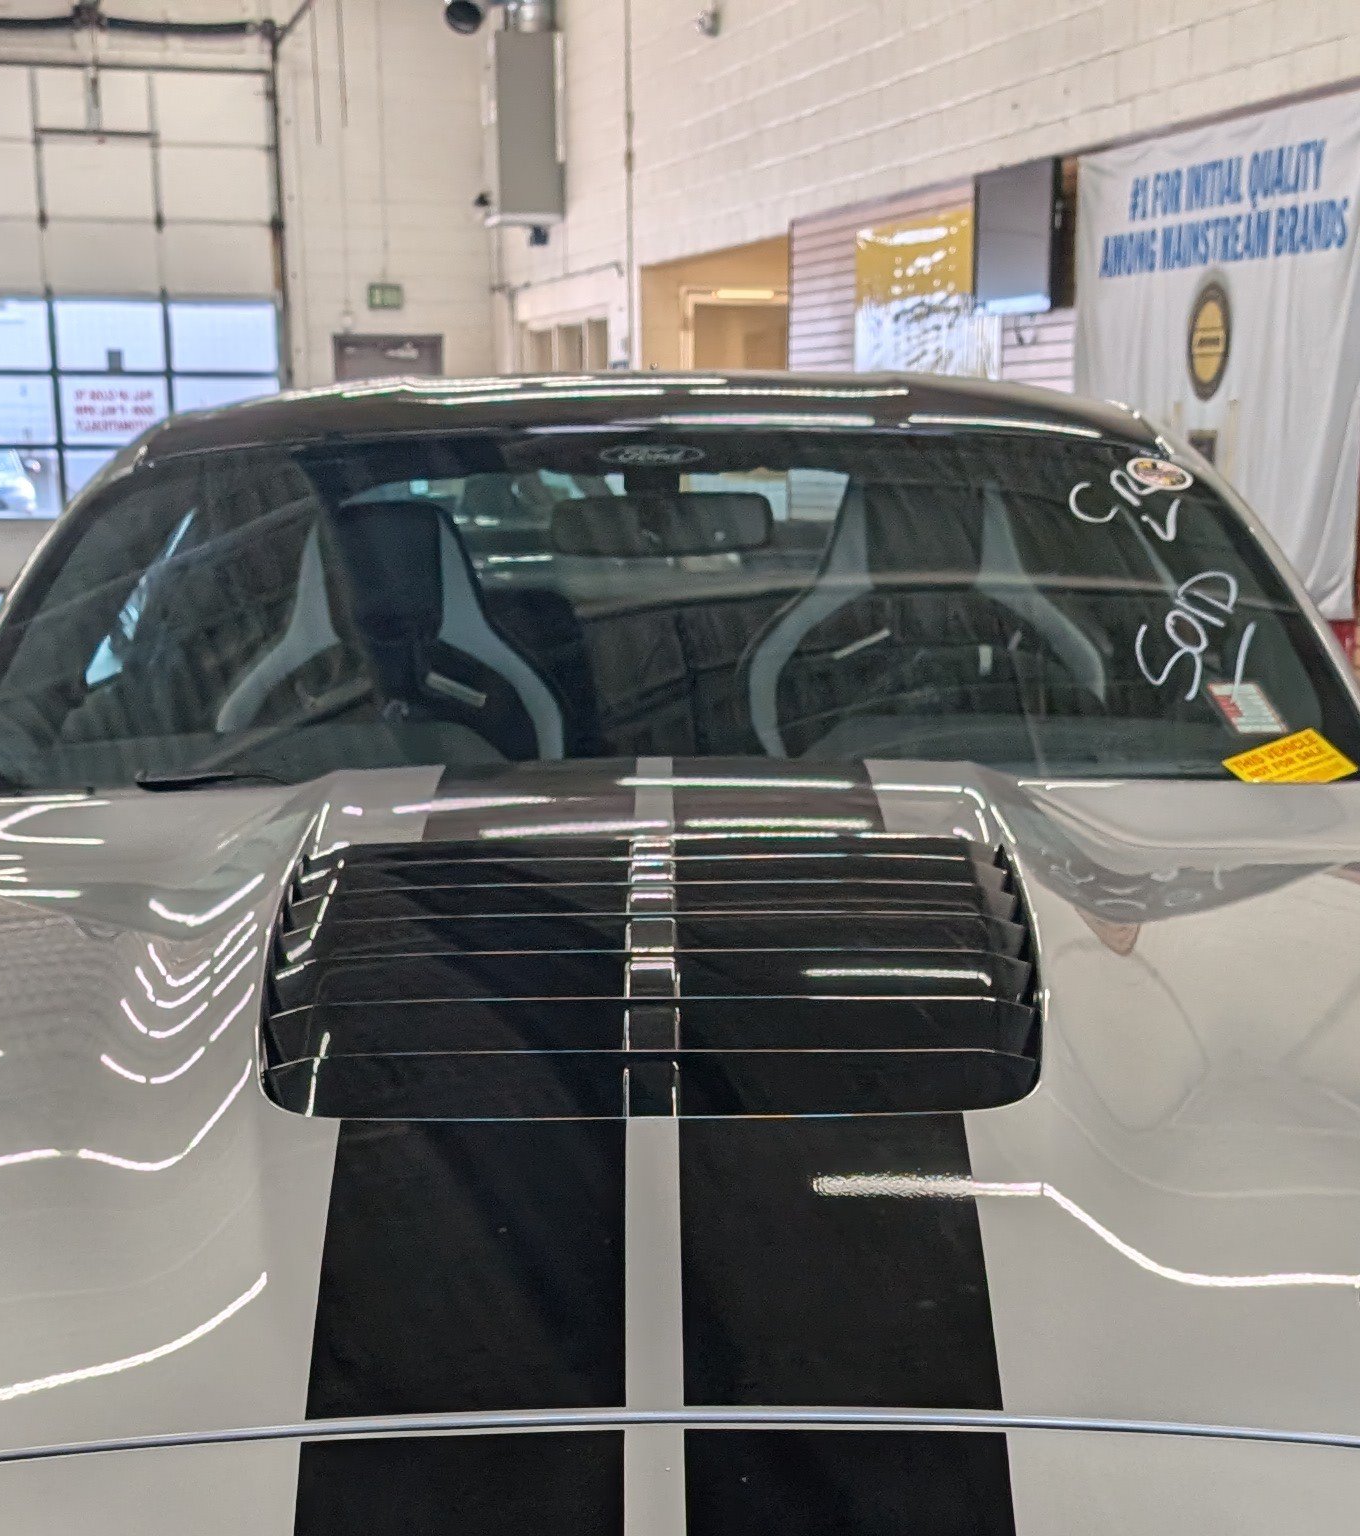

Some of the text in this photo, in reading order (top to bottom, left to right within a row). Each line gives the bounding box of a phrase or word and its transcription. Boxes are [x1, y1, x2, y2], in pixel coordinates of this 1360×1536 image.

[1151, 167, 1183, 218] FOR
[1184, 155, 1243, 212] INITIAL
[1246, 138, 1327, 210] QUALITY
[1098, 194, 1349, 279] AMONG MAINSTREAM BRANDS
